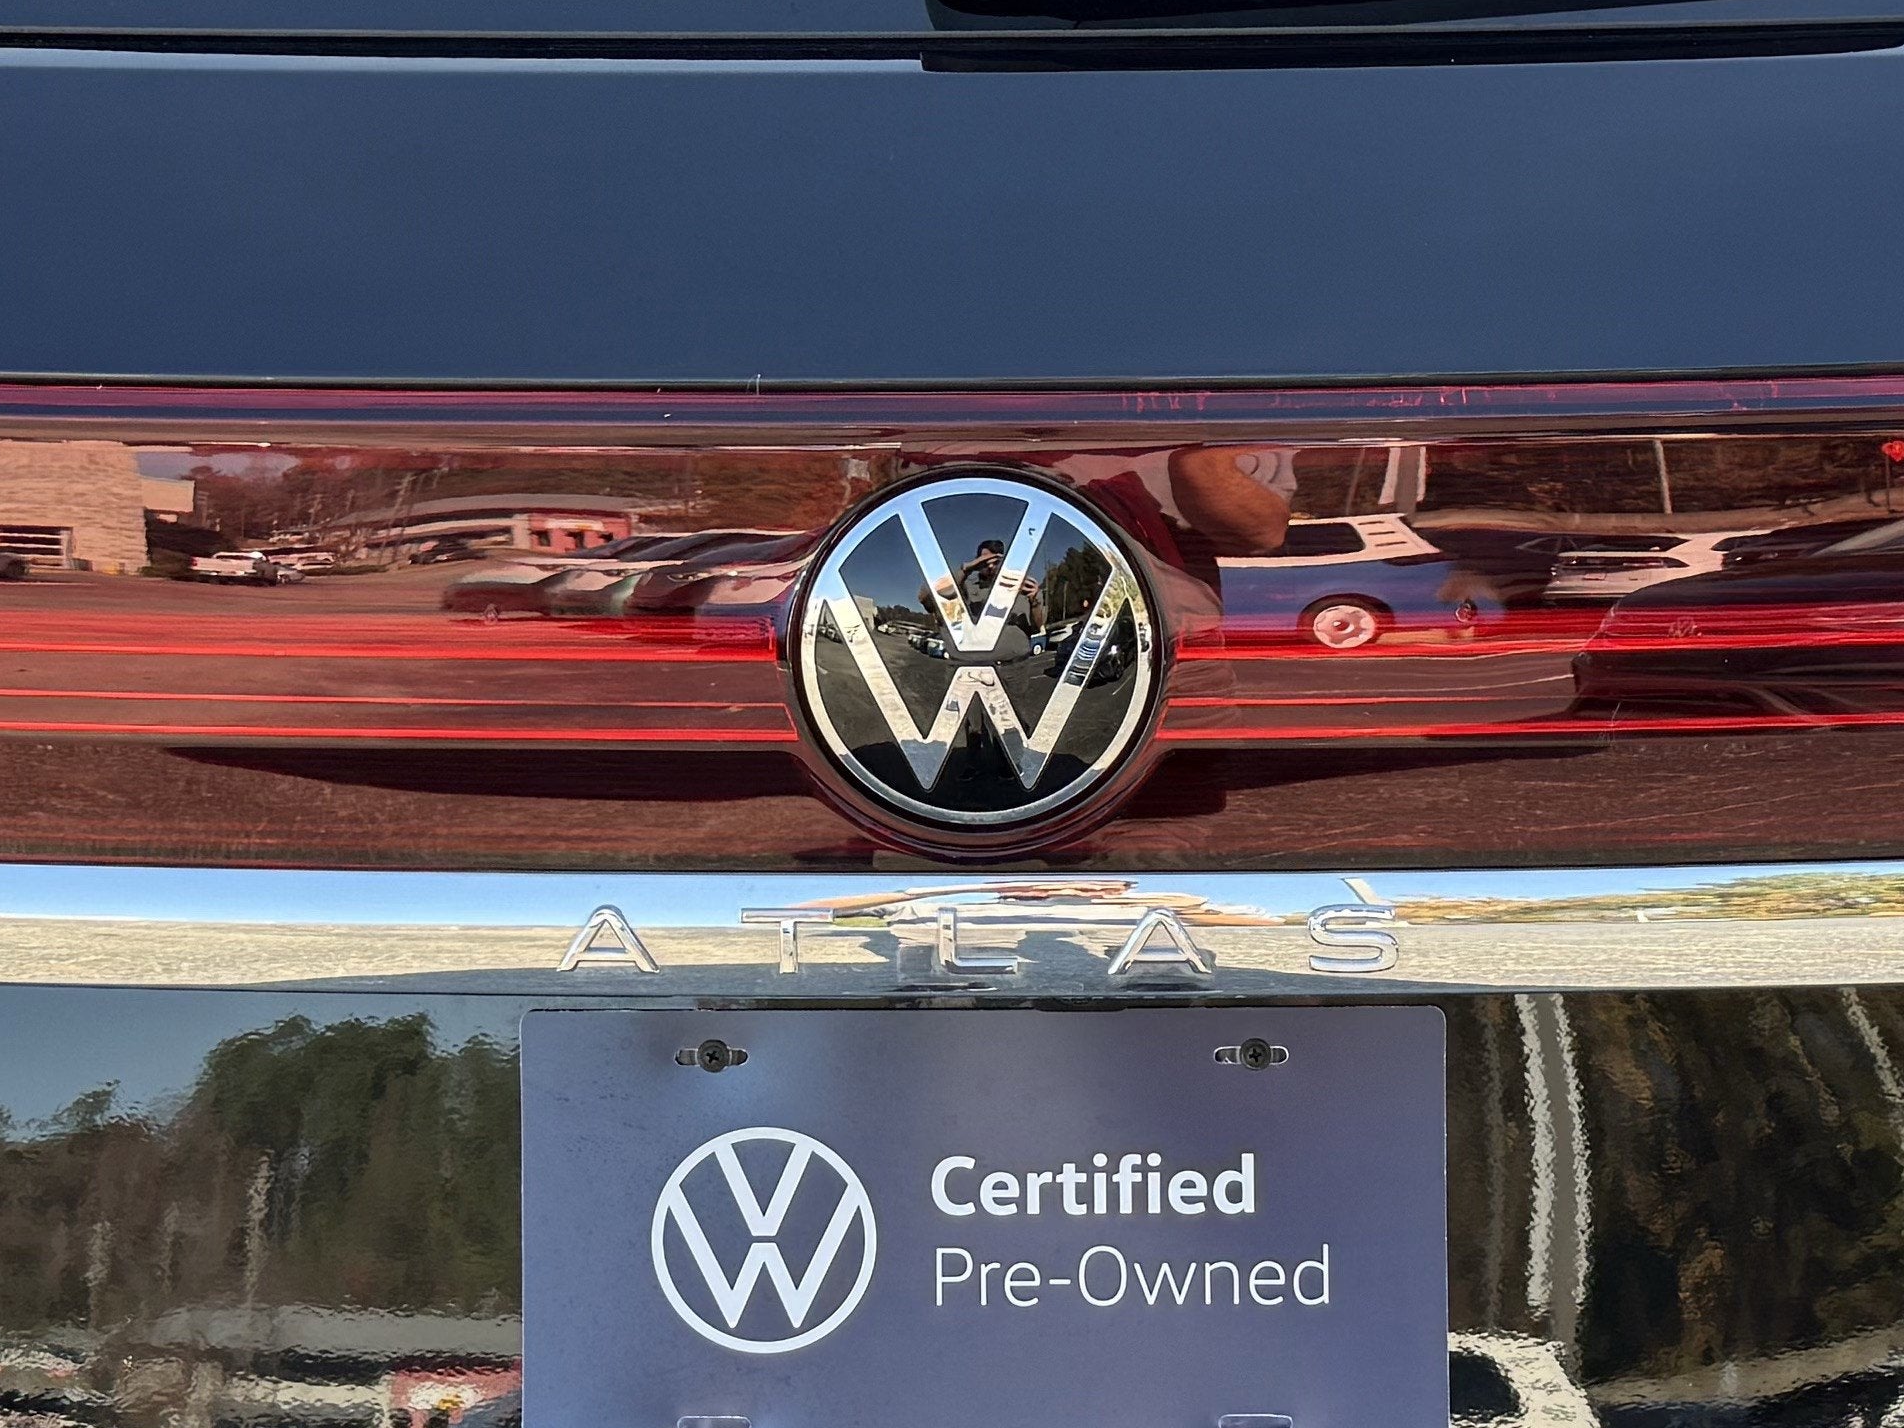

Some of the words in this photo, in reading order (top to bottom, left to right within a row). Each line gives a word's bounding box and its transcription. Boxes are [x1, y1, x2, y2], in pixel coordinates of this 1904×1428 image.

[556, 904, 1401, 975] ATLAS
[930, 1153, 1257, 1217] Certified
[935, 1242, 1331, 1309] Pre-Owned
